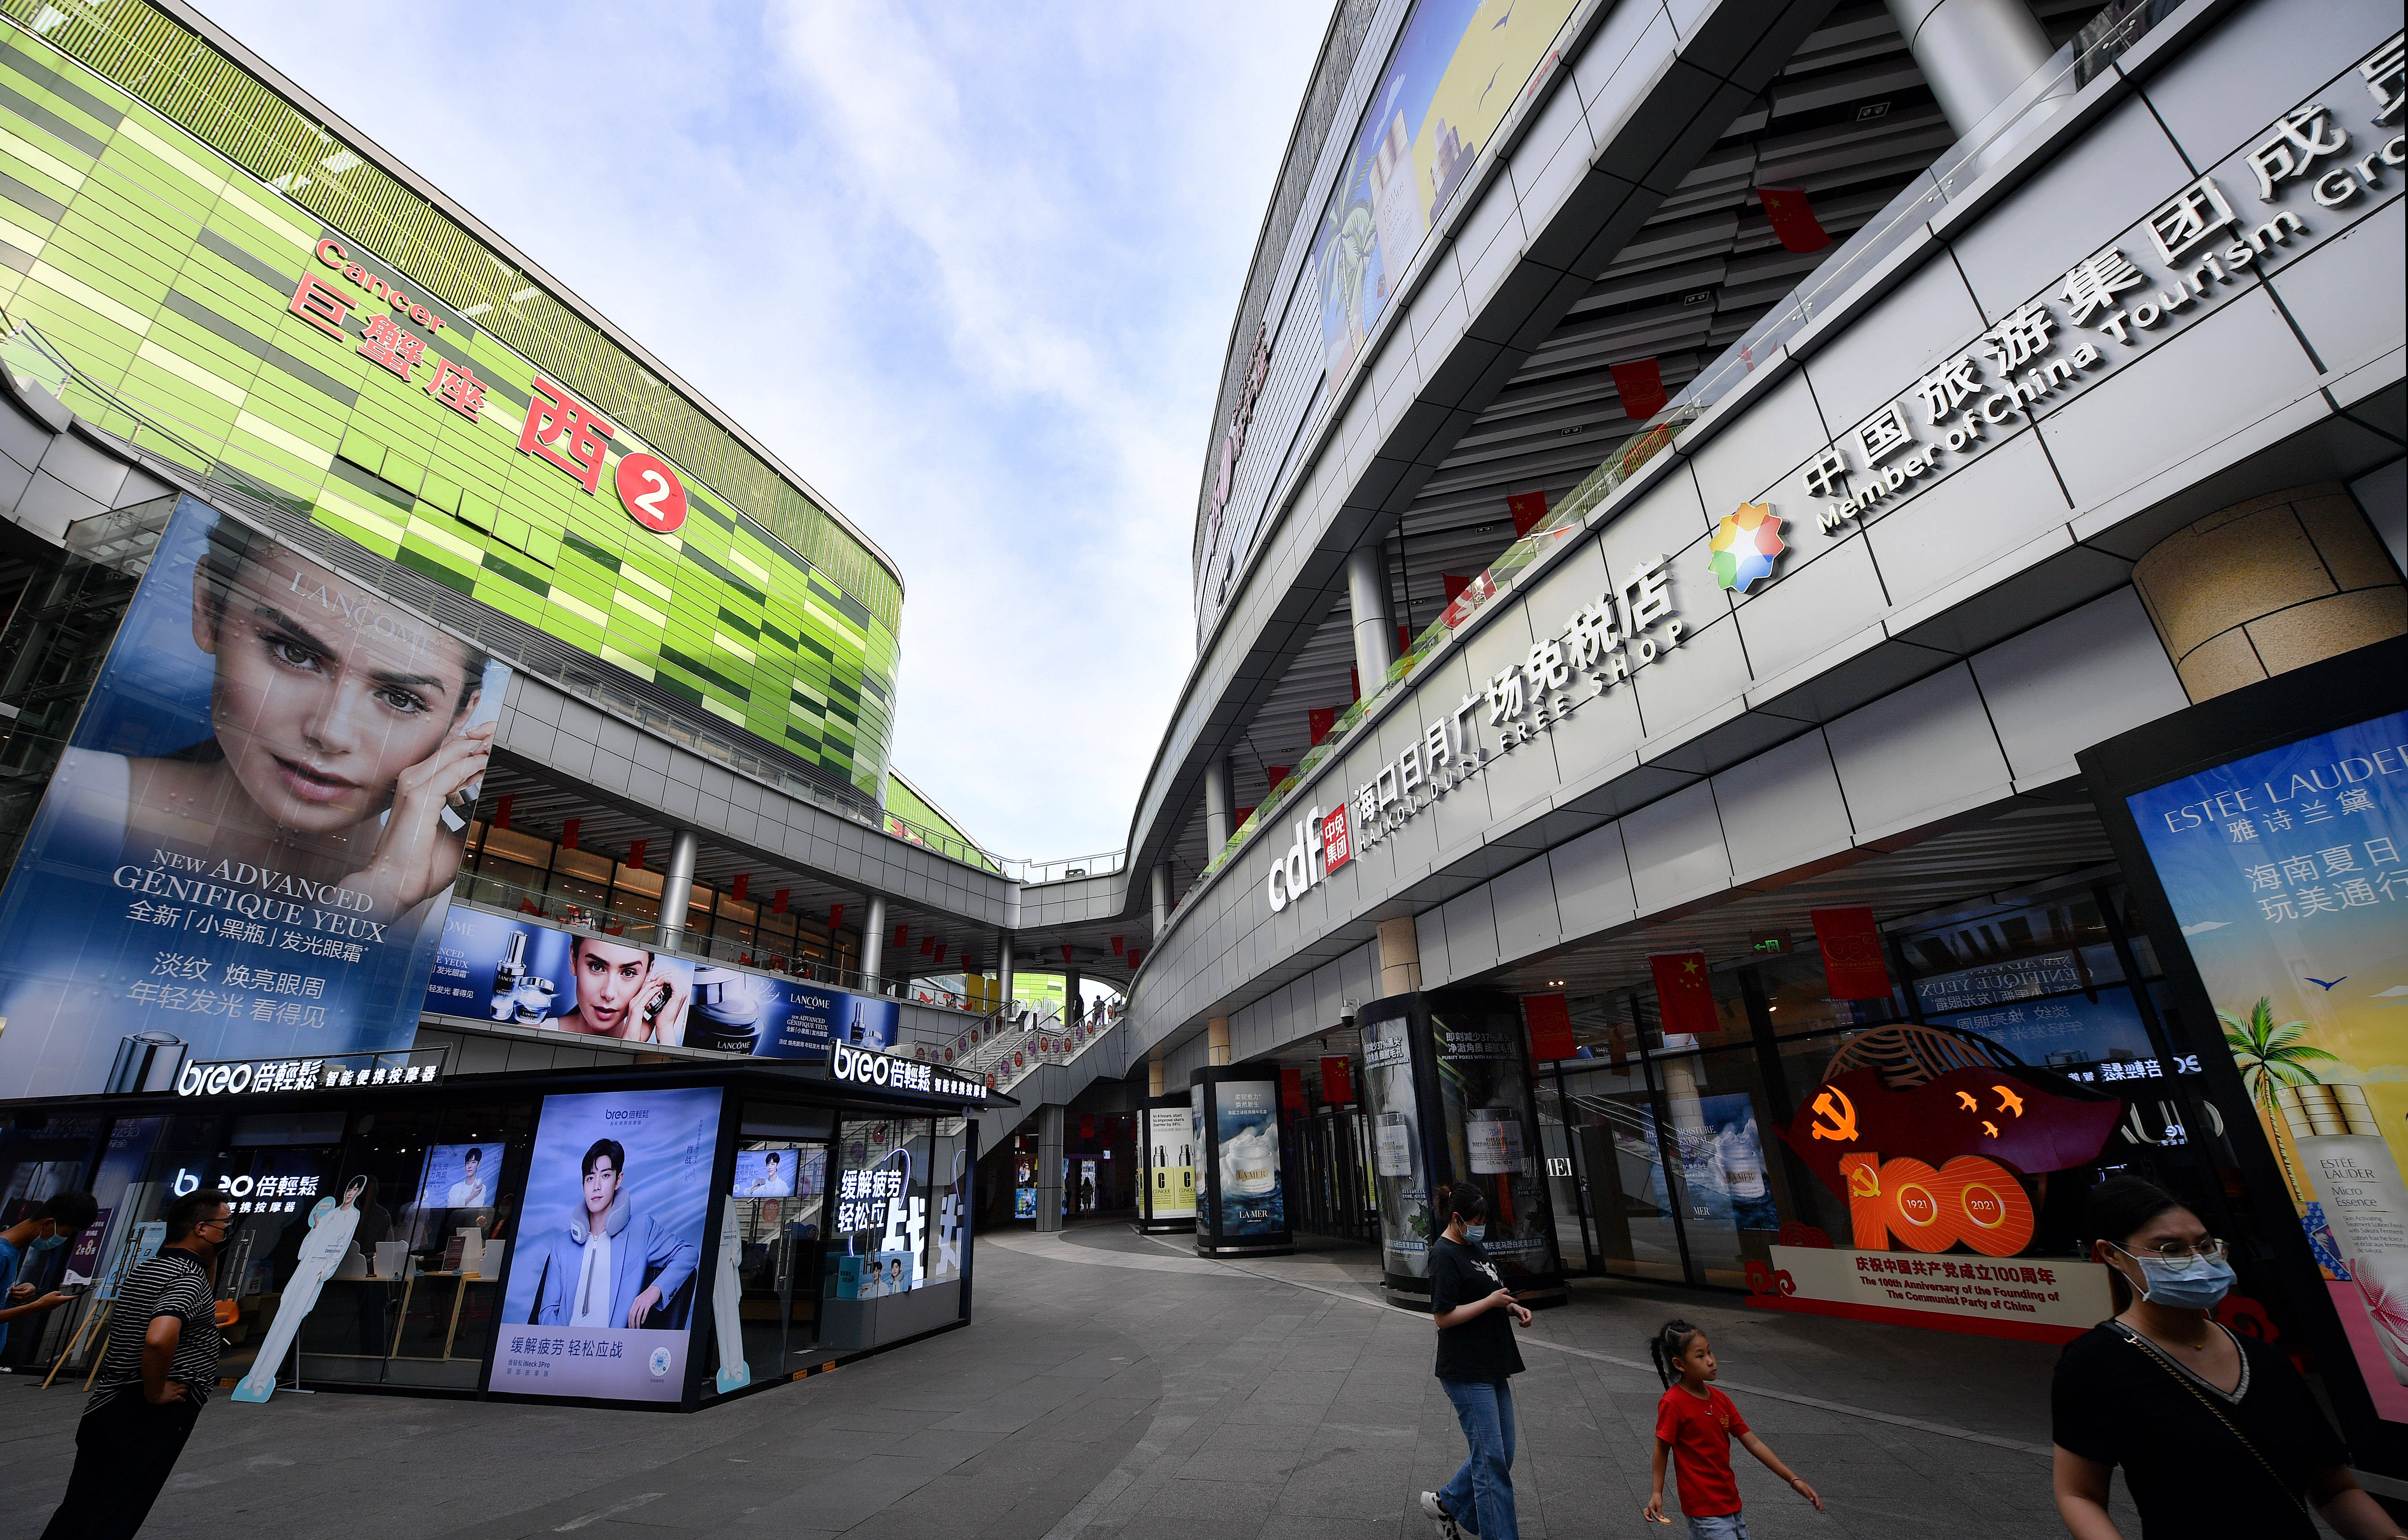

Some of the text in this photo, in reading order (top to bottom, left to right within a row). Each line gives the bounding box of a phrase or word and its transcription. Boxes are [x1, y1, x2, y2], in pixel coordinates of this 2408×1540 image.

[315, 238, 447, 335] Cancer
[288, 271, 489, 423] 巨蟹座
[1815, 440, 1937, 536] Member
[1943, 407, 1983, 453] of
[1983, 339, 2104, 426] China
[2099, 211, 2307, 344] Tourism
[515, 374, 670, 522] 西 2
[345, 622, 378, 642] PARIS
[1355, 553, 1675, 830] 海口日月广场免税店
[1359, 619, 1688, 852] HAIKOU DUTY FREE SHOP
[1325, 810, 1345, 840] 中免
[2226, 788, 2376, 844] 雅诗兰黛
[1268, 805, 1323, 912] cdf
[1326, 835, 1348, 866] 集团
[2244, 836, 2401, 894] 海南夏日
[151, 849, 374, 913] NEW ADVANCED
[113, 865, 389, 944] GÉNIFIQUE YEUX
[2257, 869, 2408, 924] 玩美通行
[150, 951, 326, 1000] 淡纹 焕亮眼周
[445, 957, 469, 968] YEUX
[126, 979, 326, 1029] 年轻发光 看得见
[452, 988, 474, 999] 看得见
[790, 993, 830, 1009] LANCÔME
[787, 1019, 814, 1029] GÉNIFIQUE
[799, 1015, 825, 1024] ADVANCED
[717, 1041, 751, 1050] LANCÔME
[178, 1059, 438, 1097] breo 倍輕鬆 智能便携按摩器
[833, 1038, 988, 1099] breo 倍輕鬆 智能便携按摩器
[606, 1109, 628, 1119] breo
[685, 1145, 693, 1164] 肖战
[174, 1168, 254, 1198] beo
[840, 1169, 902, 1201] 缓解疲劳
[1238, 1171, 1247, 1179] LA
[1738, 1173, 1754, 1182] MER
[2324, 1169, 2375, 1179] LAUDER
[1906, 1198, 1928, 1210] 1921
[2331, 1186, 2362, 1195] Micro
[2335, 1197, 2378, 1207] Essence
[1239, 1209, 1269, 1219] LA MER
[1693, 1207, 1710, 1216] MER
[1970, 1198, 1996, 1213] 2021
[1855, 1256, 2057, 1285] 庆祝中国共产党成立100周年
[1859, 1276, 2059, 1303] The 100th Anniversary of the Founding of
[1886, 1289, 2036, 1313] The Communist Party of China
[510, 1336, 624, 1359] 缓解疲劳 轻松应战
